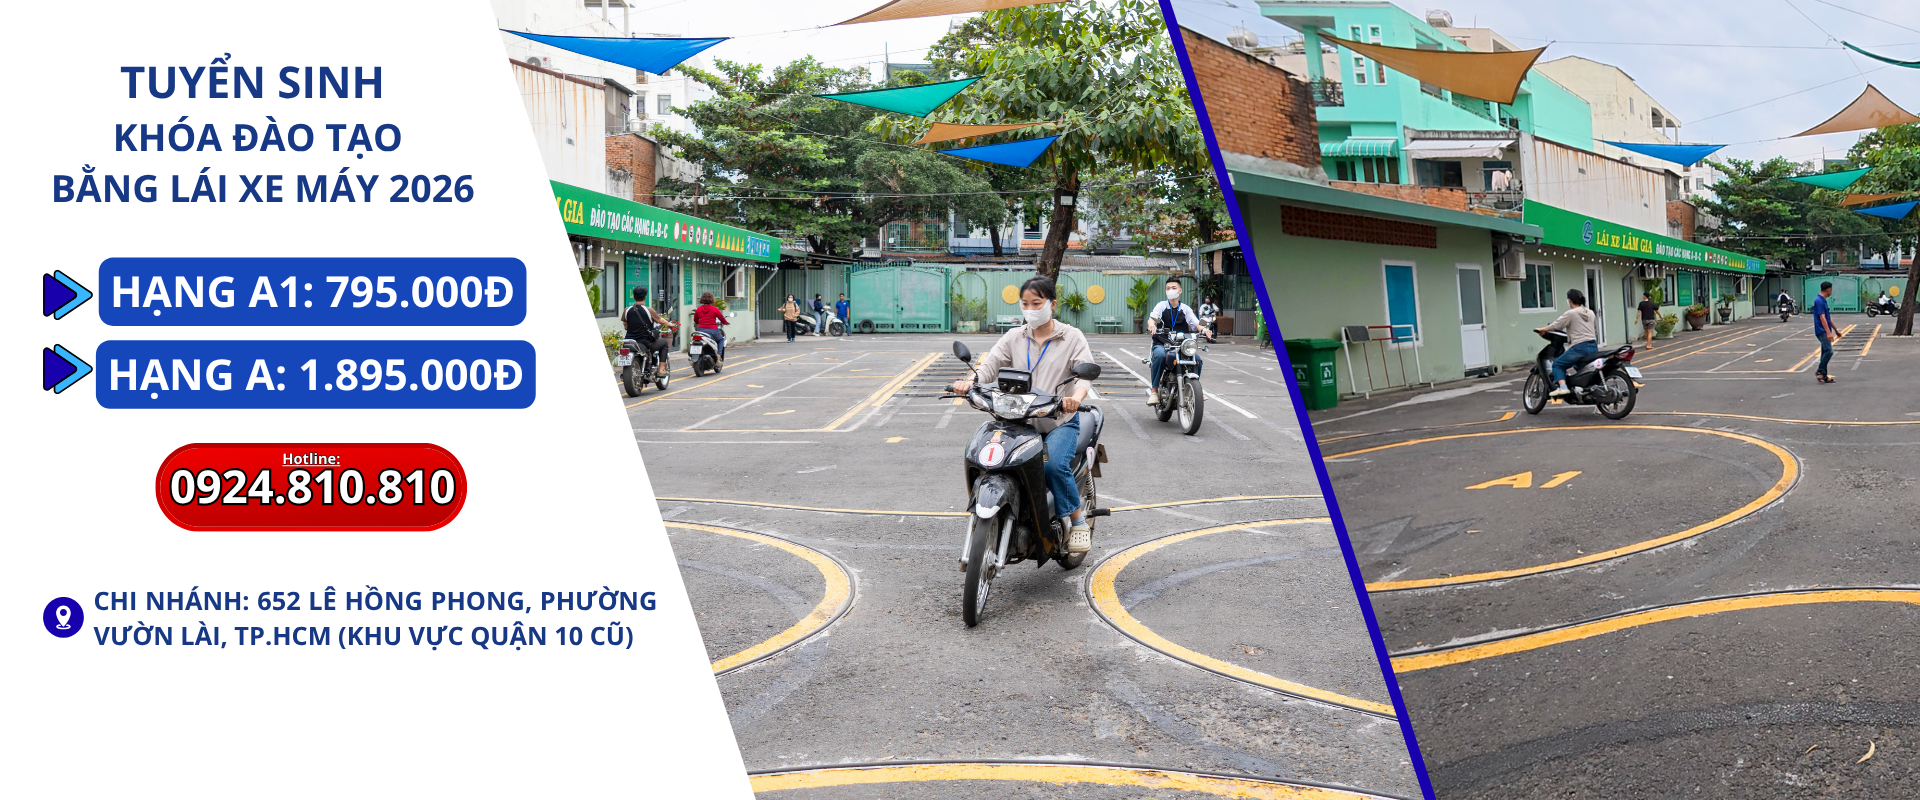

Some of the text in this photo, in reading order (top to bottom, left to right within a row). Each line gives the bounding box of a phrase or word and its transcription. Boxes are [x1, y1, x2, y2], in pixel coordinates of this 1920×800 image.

[564, 198, 584, 224] GIA
[590, 204, 606, 229] ĐÀO
[607, 211, 620, 234] TẠO
[621, 210, 634, 234] CÁC
[634, 217, 650, 238] HẠNG
[1596, 230, 1608, 246] LÁI
[1610, 236, 1620, 248] XE
[1622, 232, 1639, 251] LÂM
[1640, 240, 1652, 253] GIA
[987, 447, 994, 462] 1
[1464, 470, 1582, 490] A1
